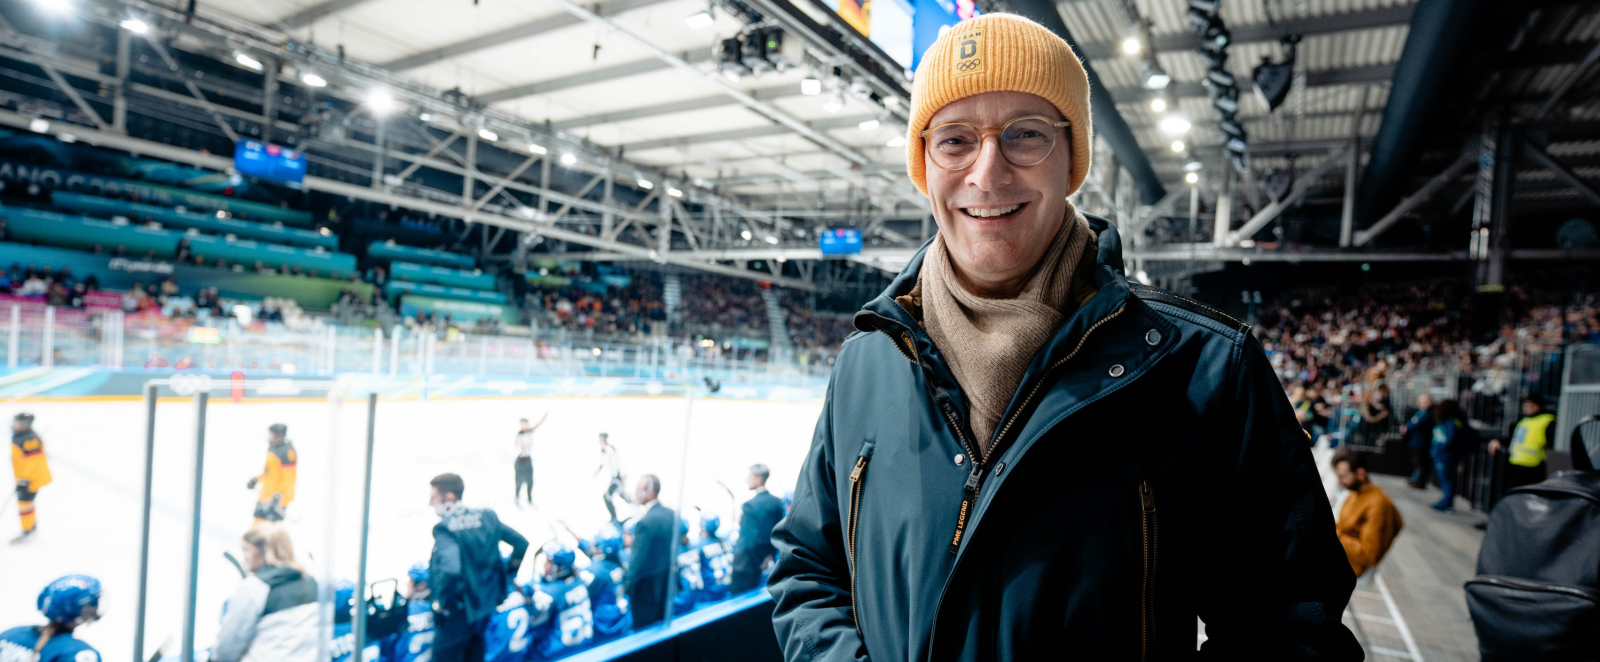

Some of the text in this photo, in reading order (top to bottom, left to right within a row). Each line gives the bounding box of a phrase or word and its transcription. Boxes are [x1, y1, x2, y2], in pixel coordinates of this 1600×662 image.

[958, 32, 982, 41] TEAM
[960, 40, 977, 59] D
[952, 500, 968, 546] PME LEGEND
[507, 607, 530, 653] 2
